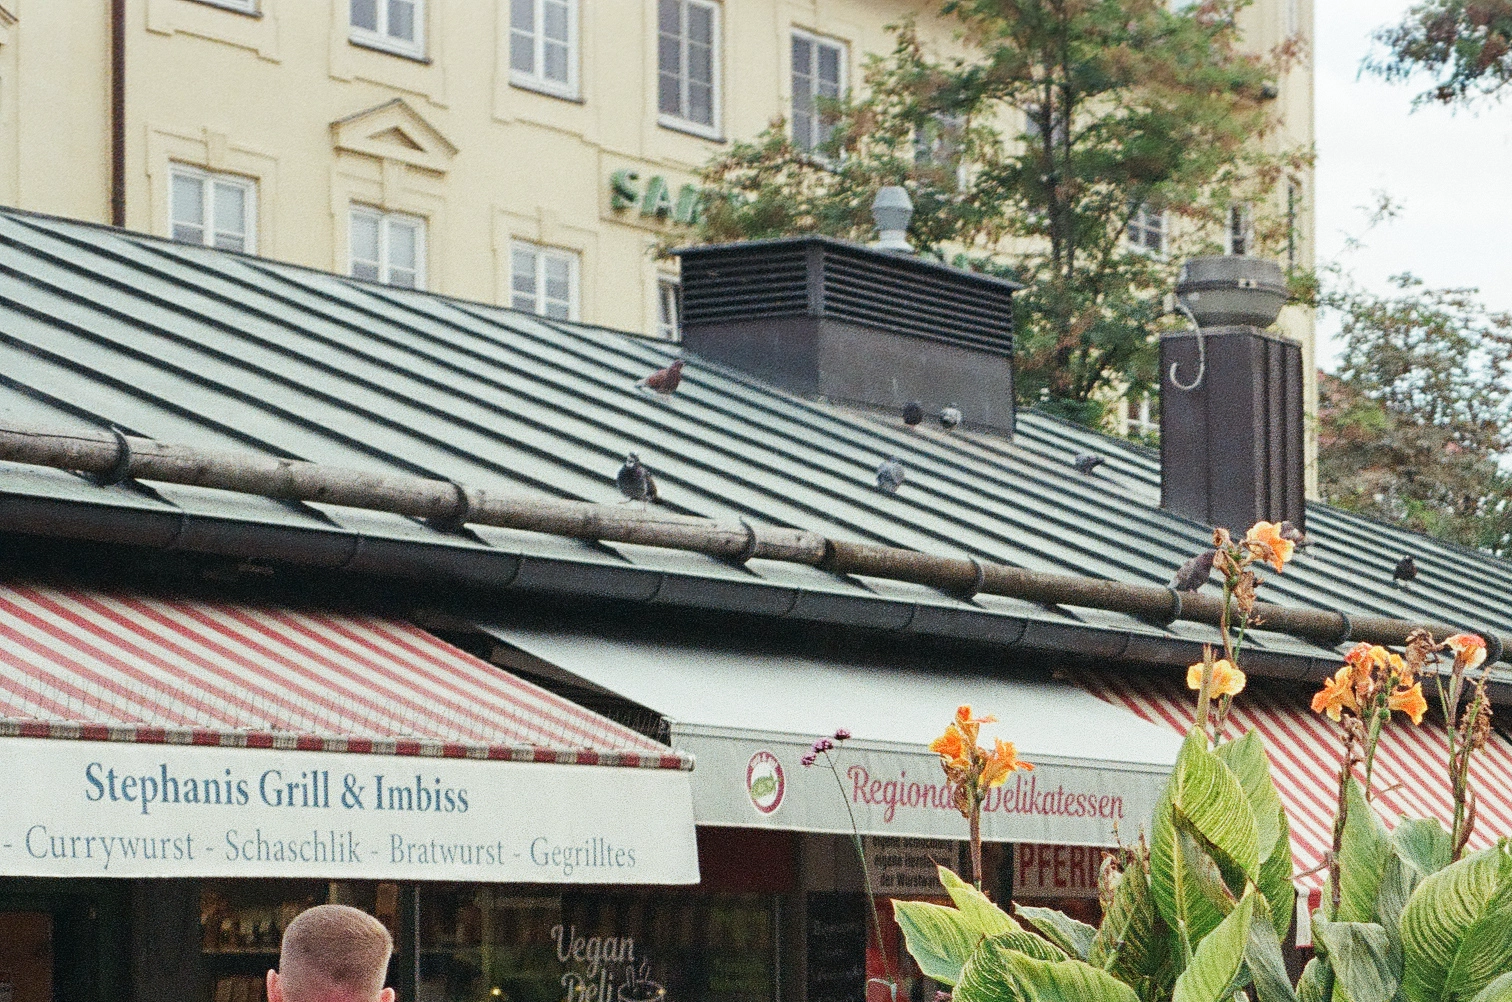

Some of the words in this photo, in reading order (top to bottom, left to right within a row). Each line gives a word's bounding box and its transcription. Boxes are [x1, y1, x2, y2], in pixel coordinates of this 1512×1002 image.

[85, 762, 249, 815] Stephanis
[259, 769, 330, 808] Grill
[340, 772, 365, 810] &
[374, 773, 470, 813] Imbiss
[847, 764, 957, 823] Regiona
[983, 774, 1125, 819] Delikatessen
[25, 824, 195, 870] Currywurst
[225, 828, 362, 863] Schaschlik
[389, 832, 505, 866] Bratwurst
[530, 836, 637, 876] Gegrilltes
[550, 923, 636, 978] Vegan
